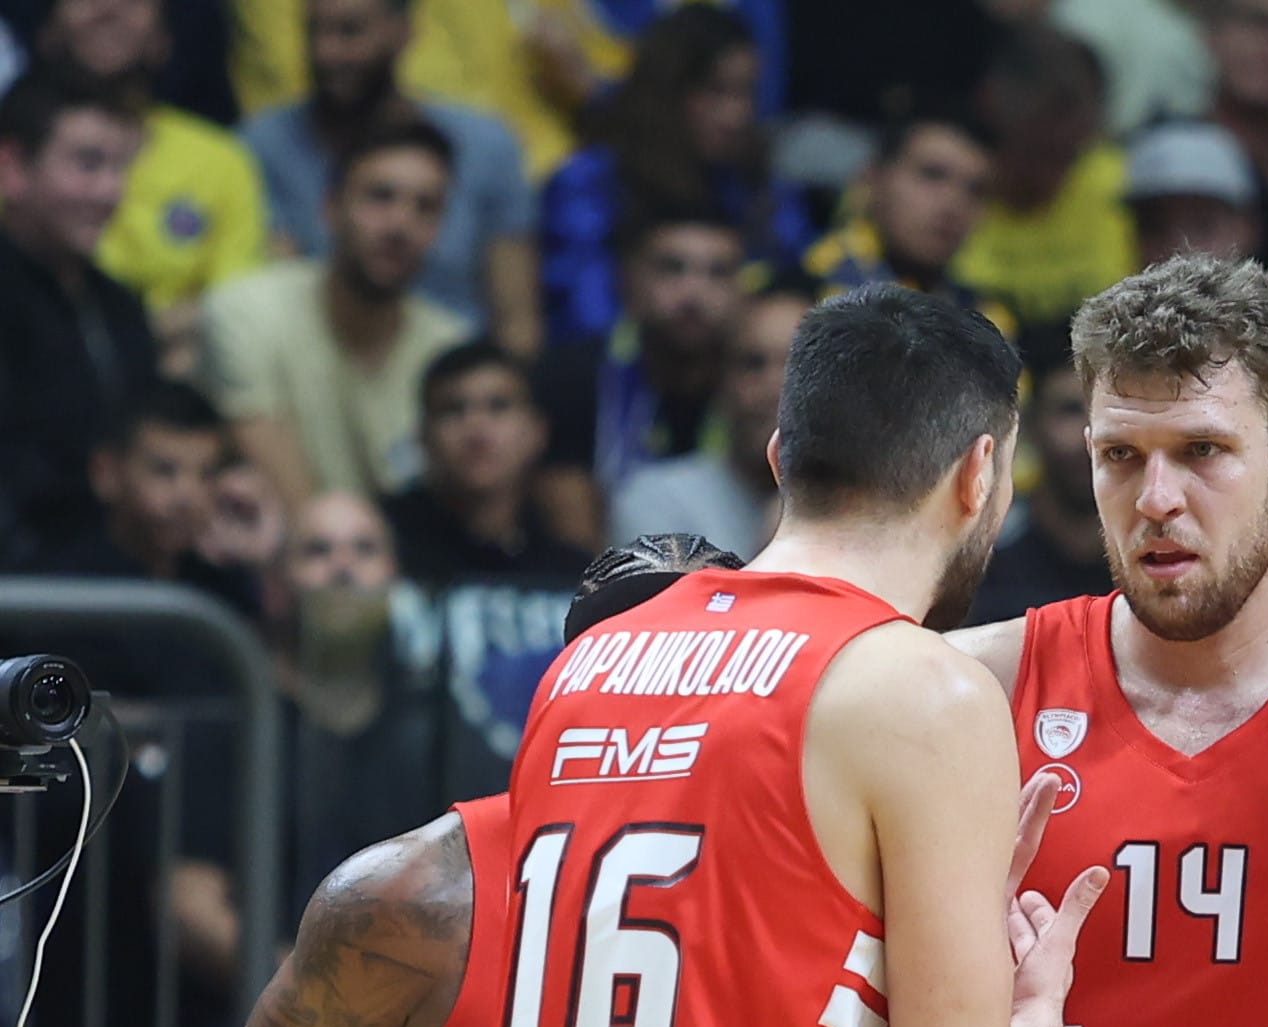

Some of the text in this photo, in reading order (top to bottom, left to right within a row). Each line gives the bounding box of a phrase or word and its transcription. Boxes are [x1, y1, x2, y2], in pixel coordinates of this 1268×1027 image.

[549, 629, 809, 700] PAPANIKOLAOU
[551, 722, 709, 781] FMS
[1113, 840, 1248, 964] 14
